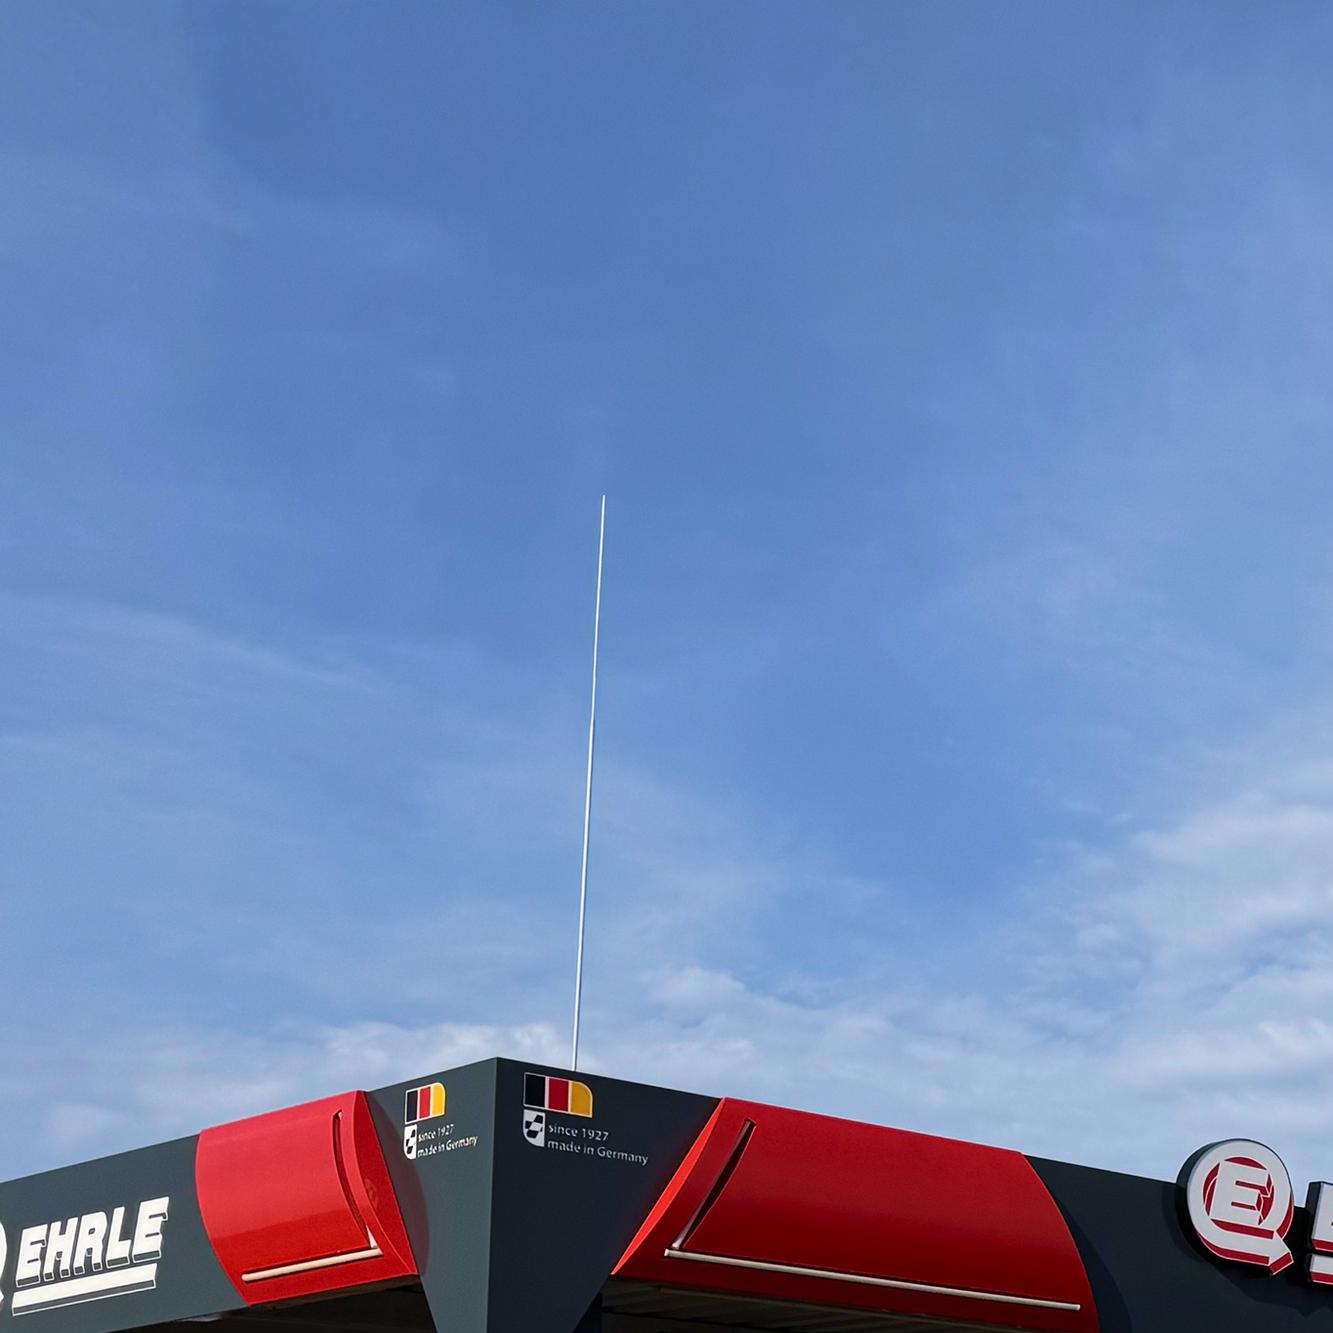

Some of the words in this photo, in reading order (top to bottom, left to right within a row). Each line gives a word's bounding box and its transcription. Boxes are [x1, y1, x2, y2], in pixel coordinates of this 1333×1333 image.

[418, 1130, 437, 1142] since
[437, 1124, 455, 1138] 1927
[548, 1123, 578, 1138] since
[582, 1127, 609, 1141] 1927
[417, 1144, 438, 1158] made
[446, 1135, 478, 1152] Germany
[547, 1139, 582, 1153] made
[583, 1143, 594, 1156] in
[596, 1147, 649, 1166] Germany
[16, 1197, 169, 1287] EHRLE
